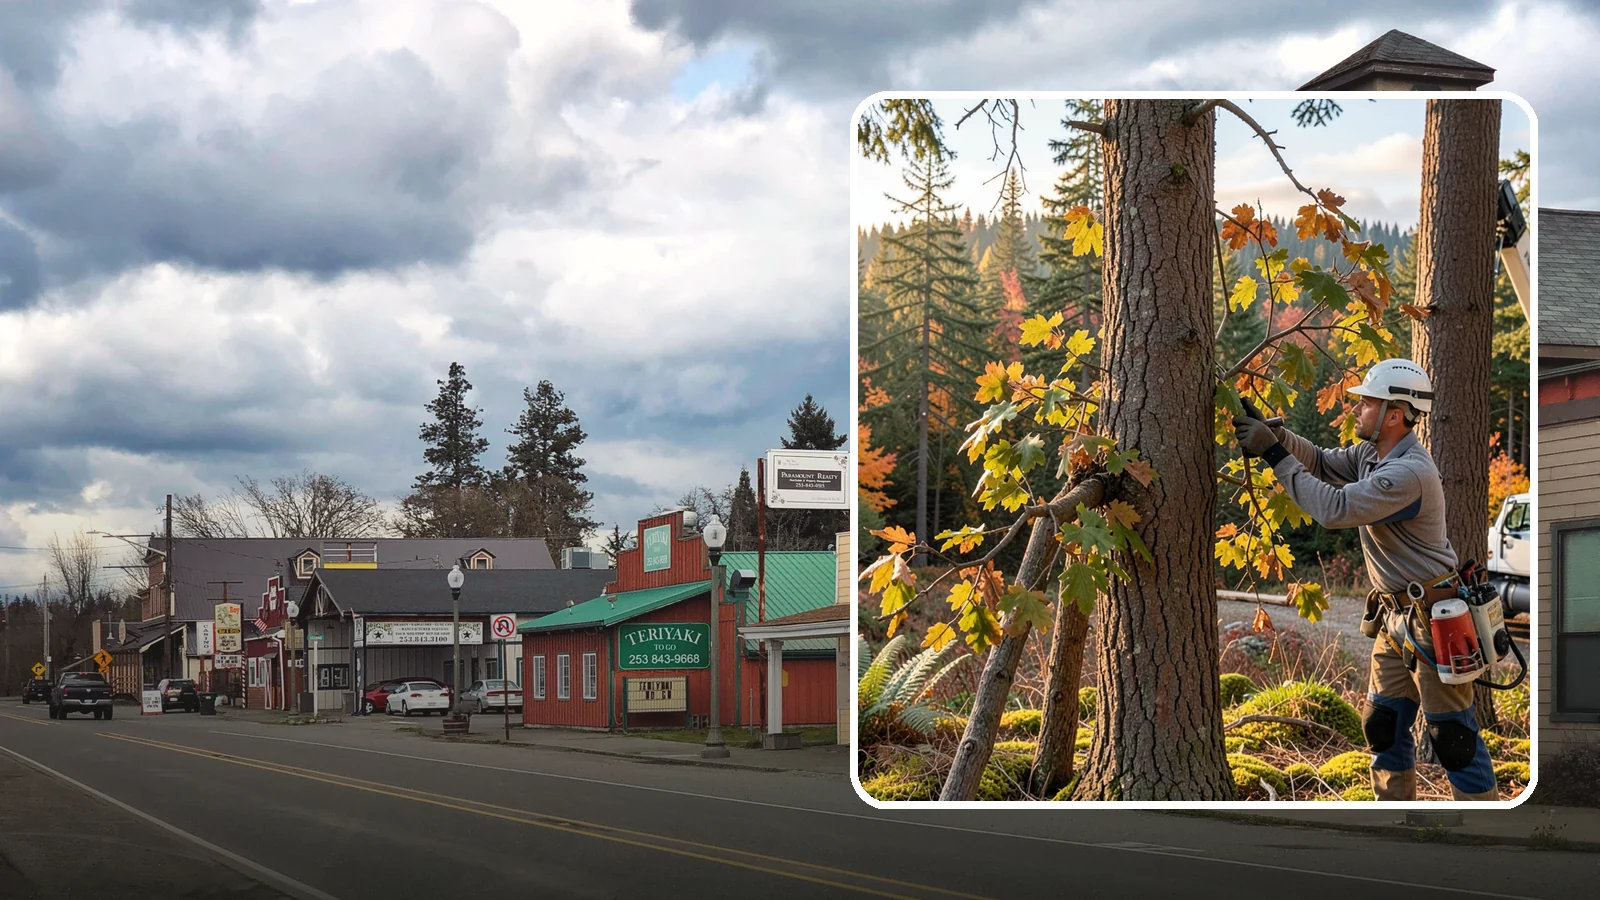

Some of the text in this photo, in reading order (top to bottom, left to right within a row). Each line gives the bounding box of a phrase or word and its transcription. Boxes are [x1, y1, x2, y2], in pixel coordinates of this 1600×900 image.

[625, 627, 703, 646] TERIYAKI
[629, 653, 700, 665] 253 843-9668
[639, 681, 672, 691] TERIYAKI
